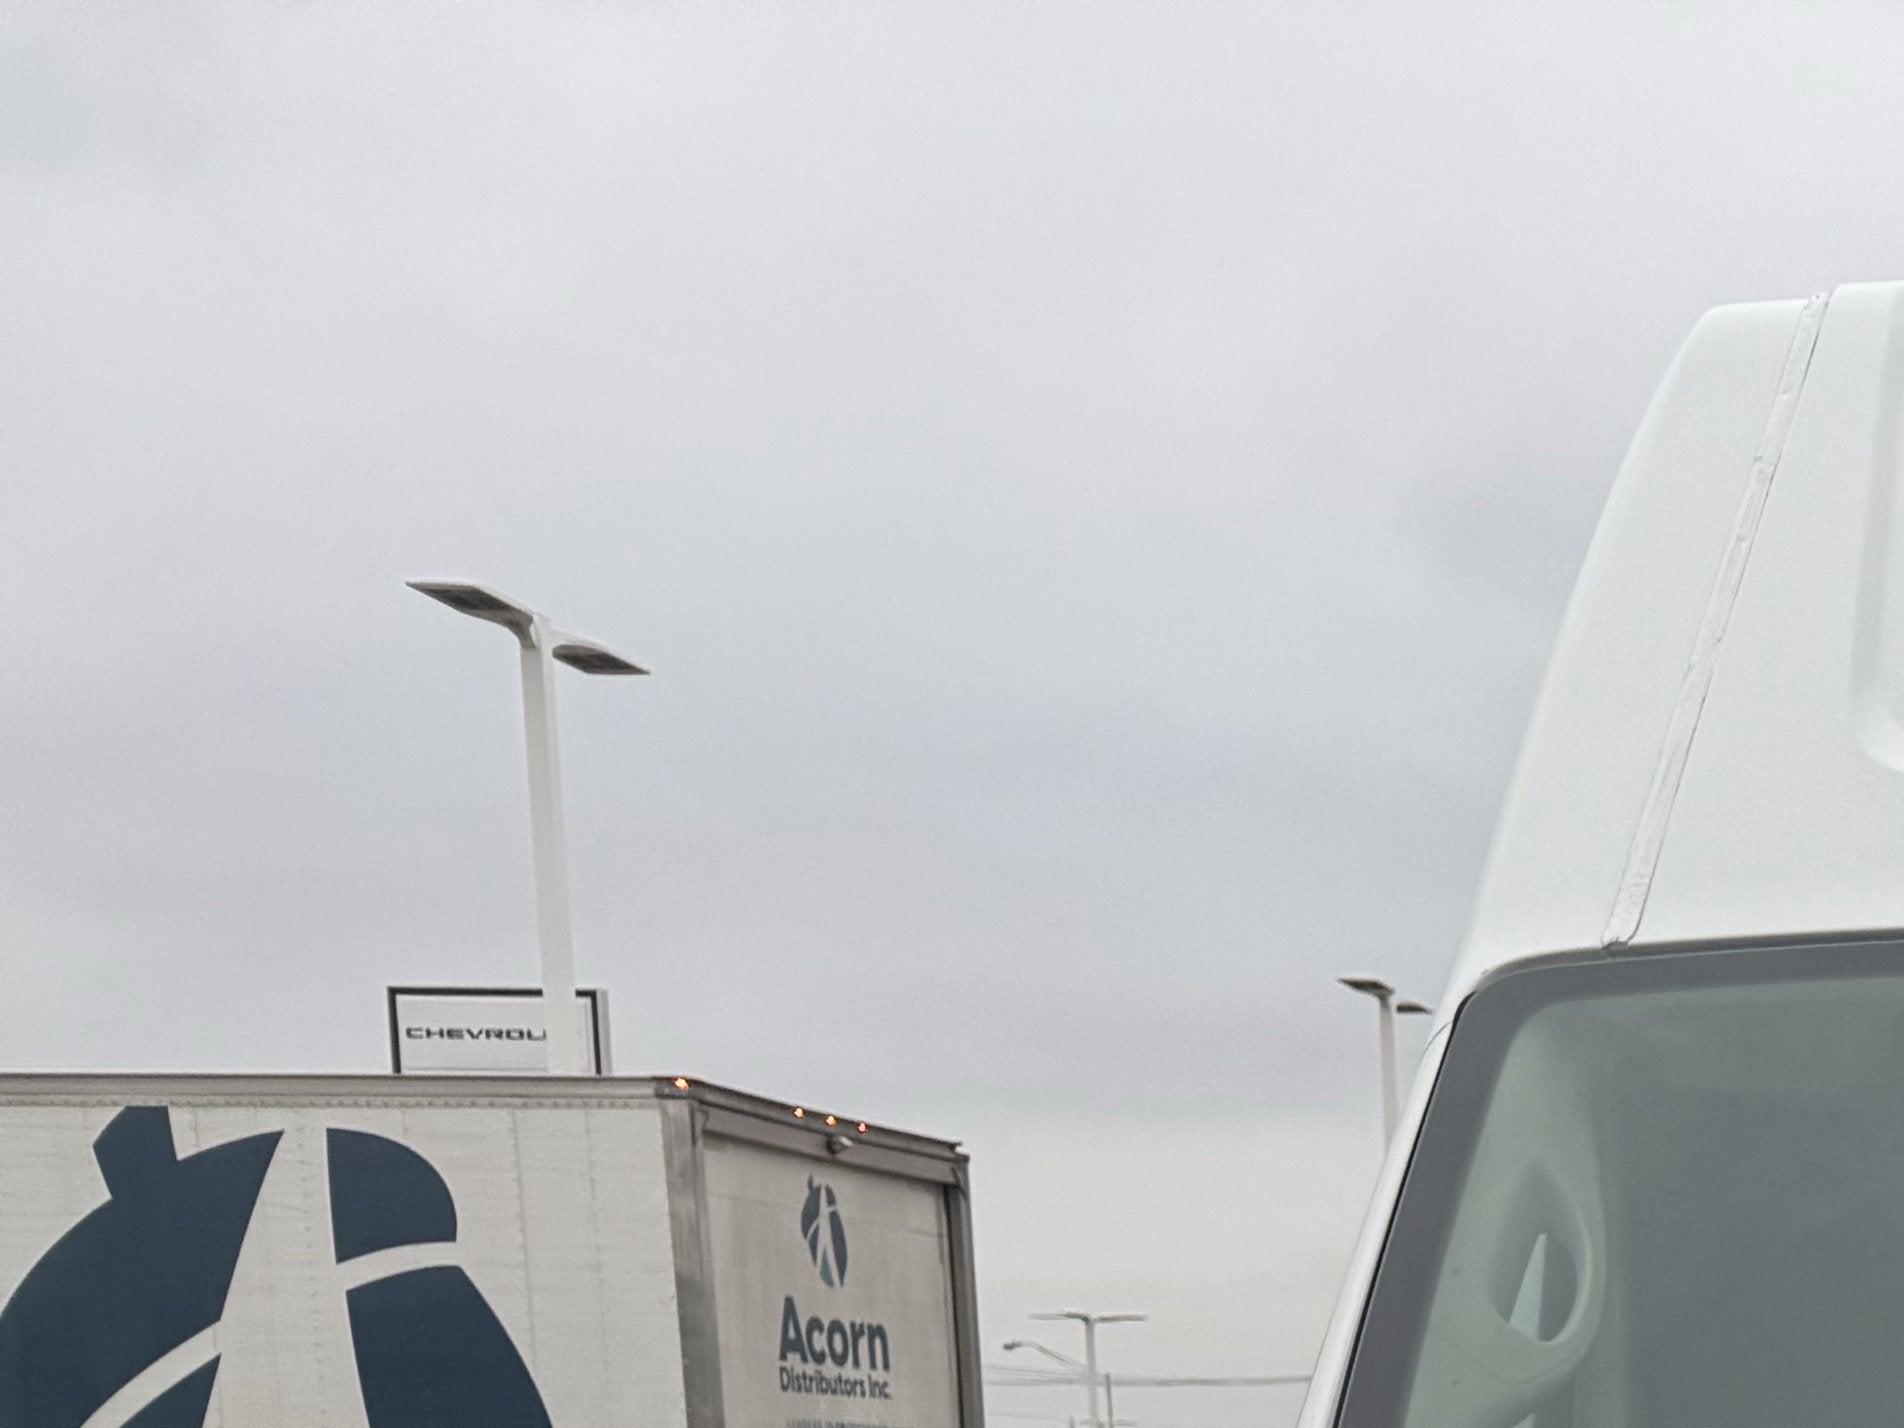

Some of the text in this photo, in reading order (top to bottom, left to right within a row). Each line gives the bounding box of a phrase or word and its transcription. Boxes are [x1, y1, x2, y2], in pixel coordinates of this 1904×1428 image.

[406, 1027, 546, 1040] CHEVROL
[779, 1295, 890, 1372] Acorn
[779, 1365, 866, 1398] Distributors
